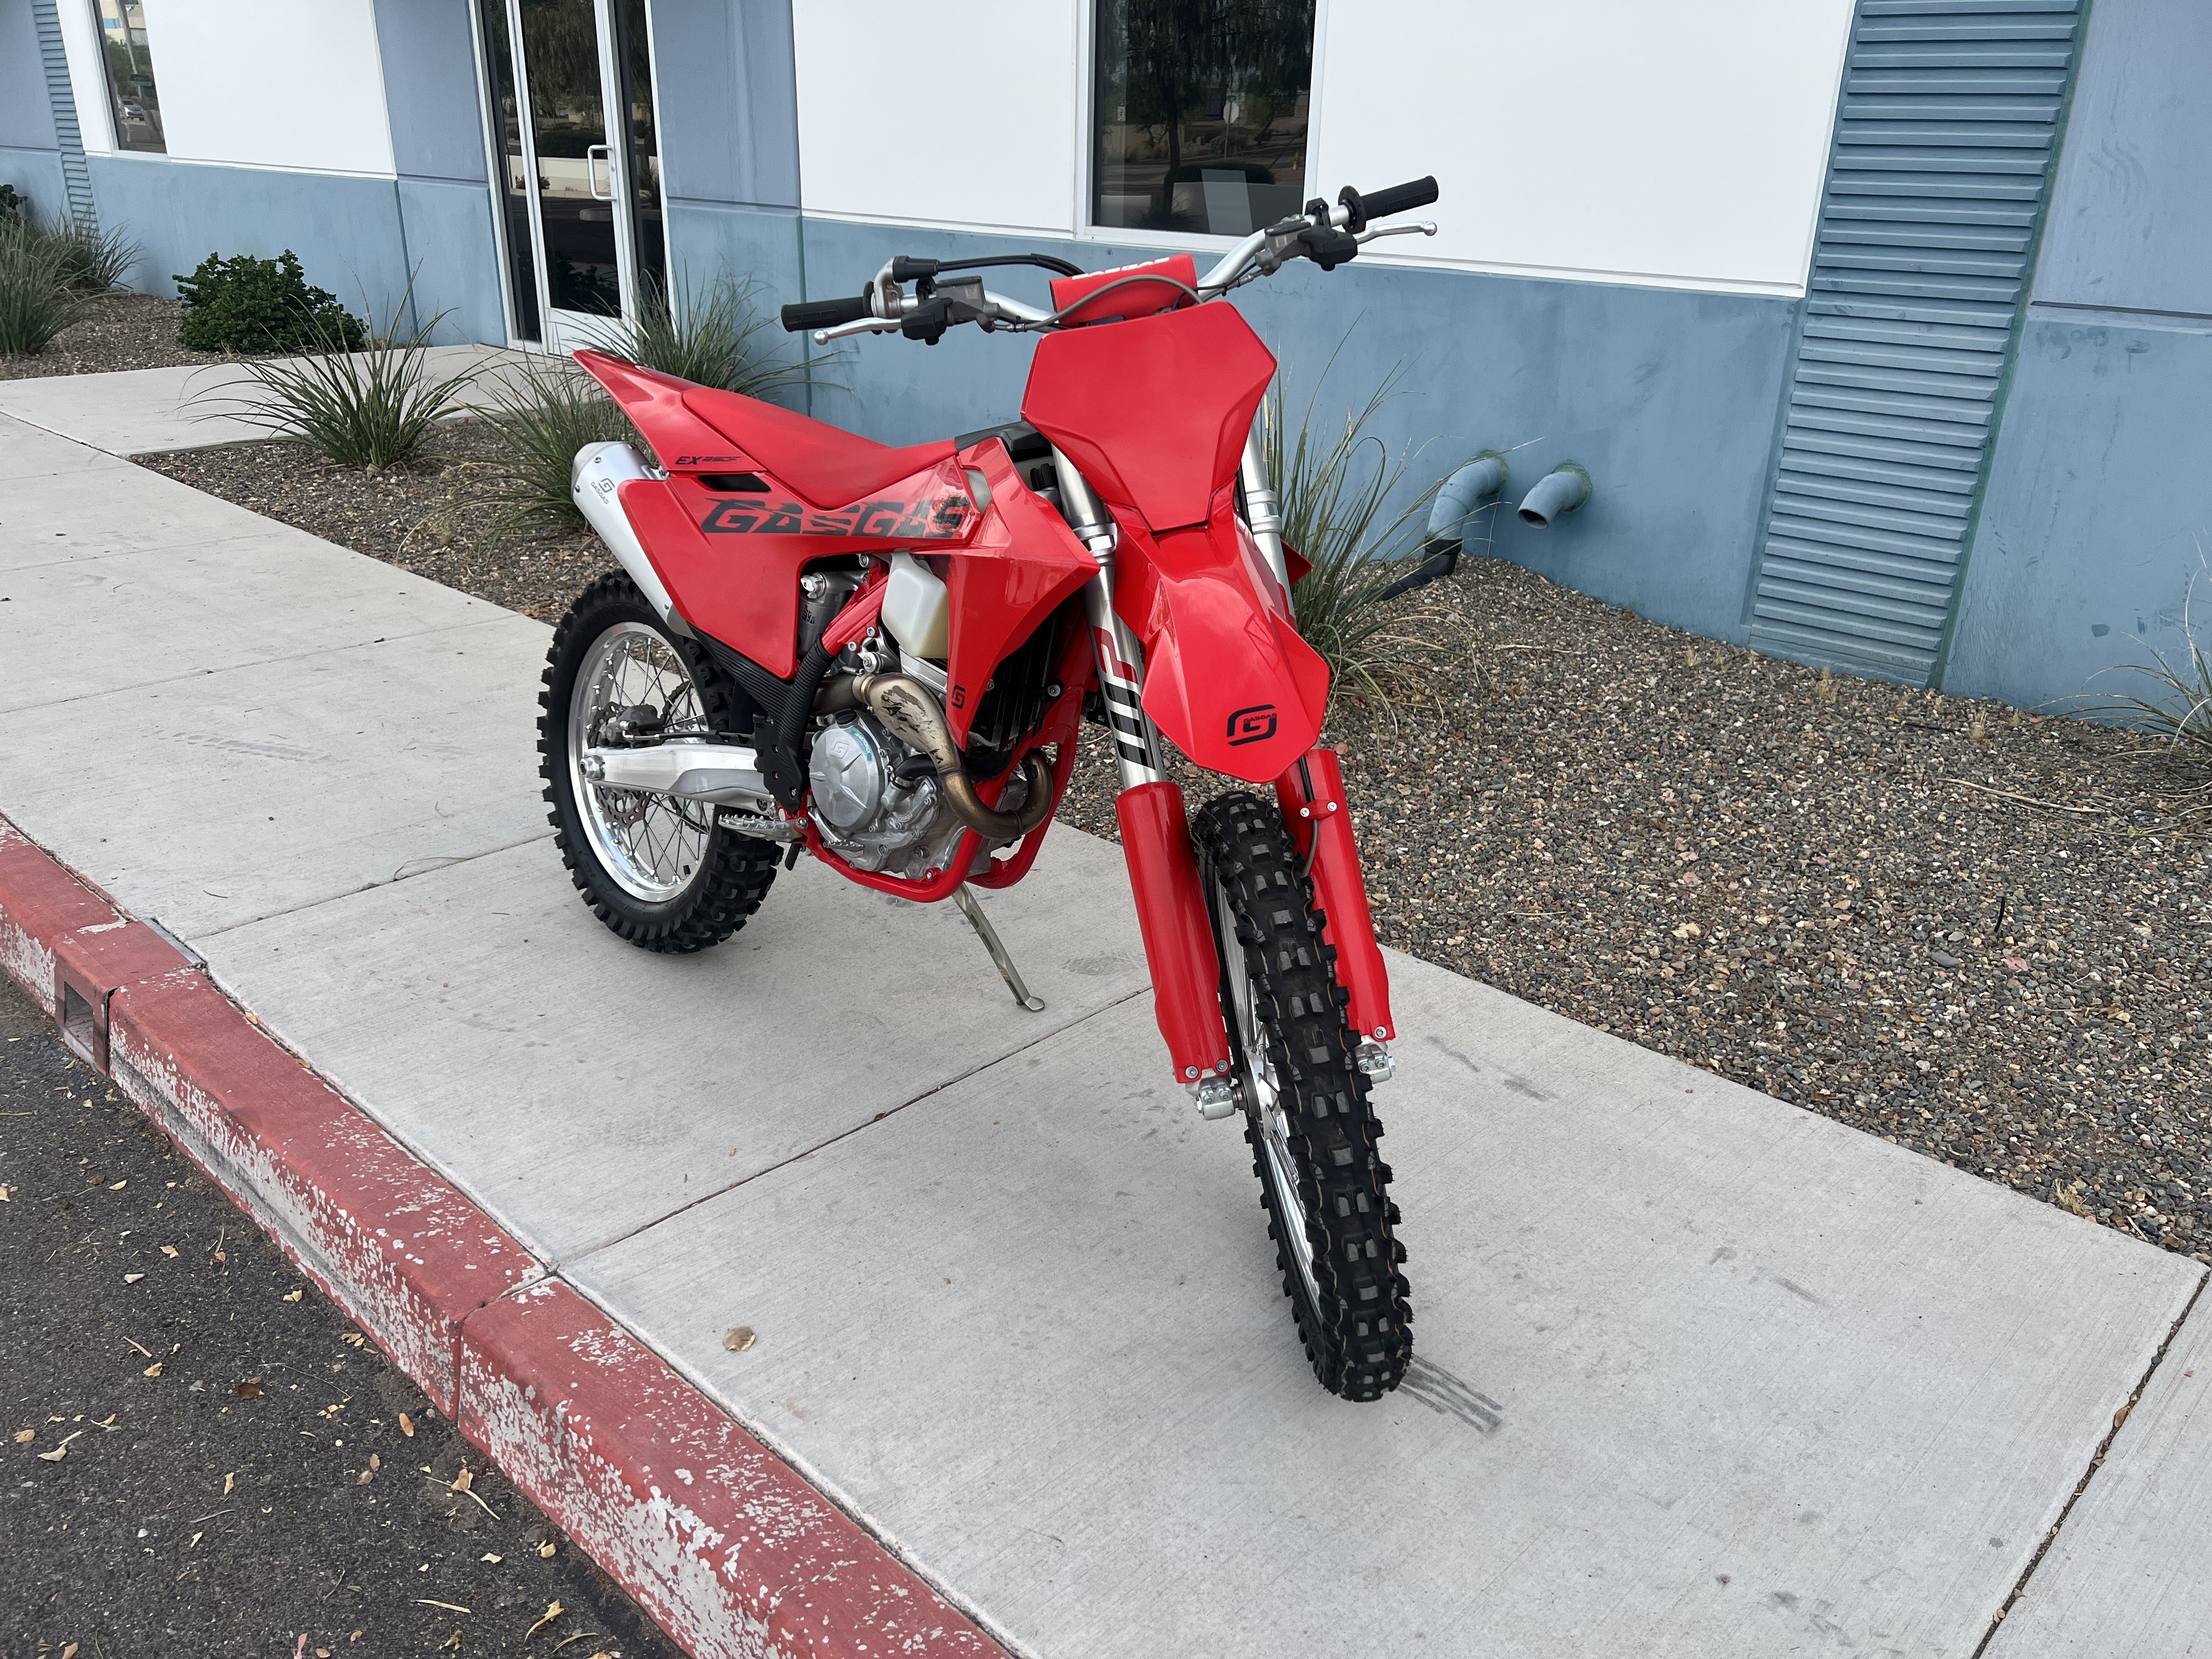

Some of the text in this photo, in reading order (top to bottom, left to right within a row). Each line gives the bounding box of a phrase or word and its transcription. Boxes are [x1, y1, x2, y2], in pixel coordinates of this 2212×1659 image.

[675, 456, 703, 465] EX
[590, 481, 610, 504] GASGAS
[700, 495, 971, 538] GASGAS
[1243, 713, 1277, 723] GASGAS
